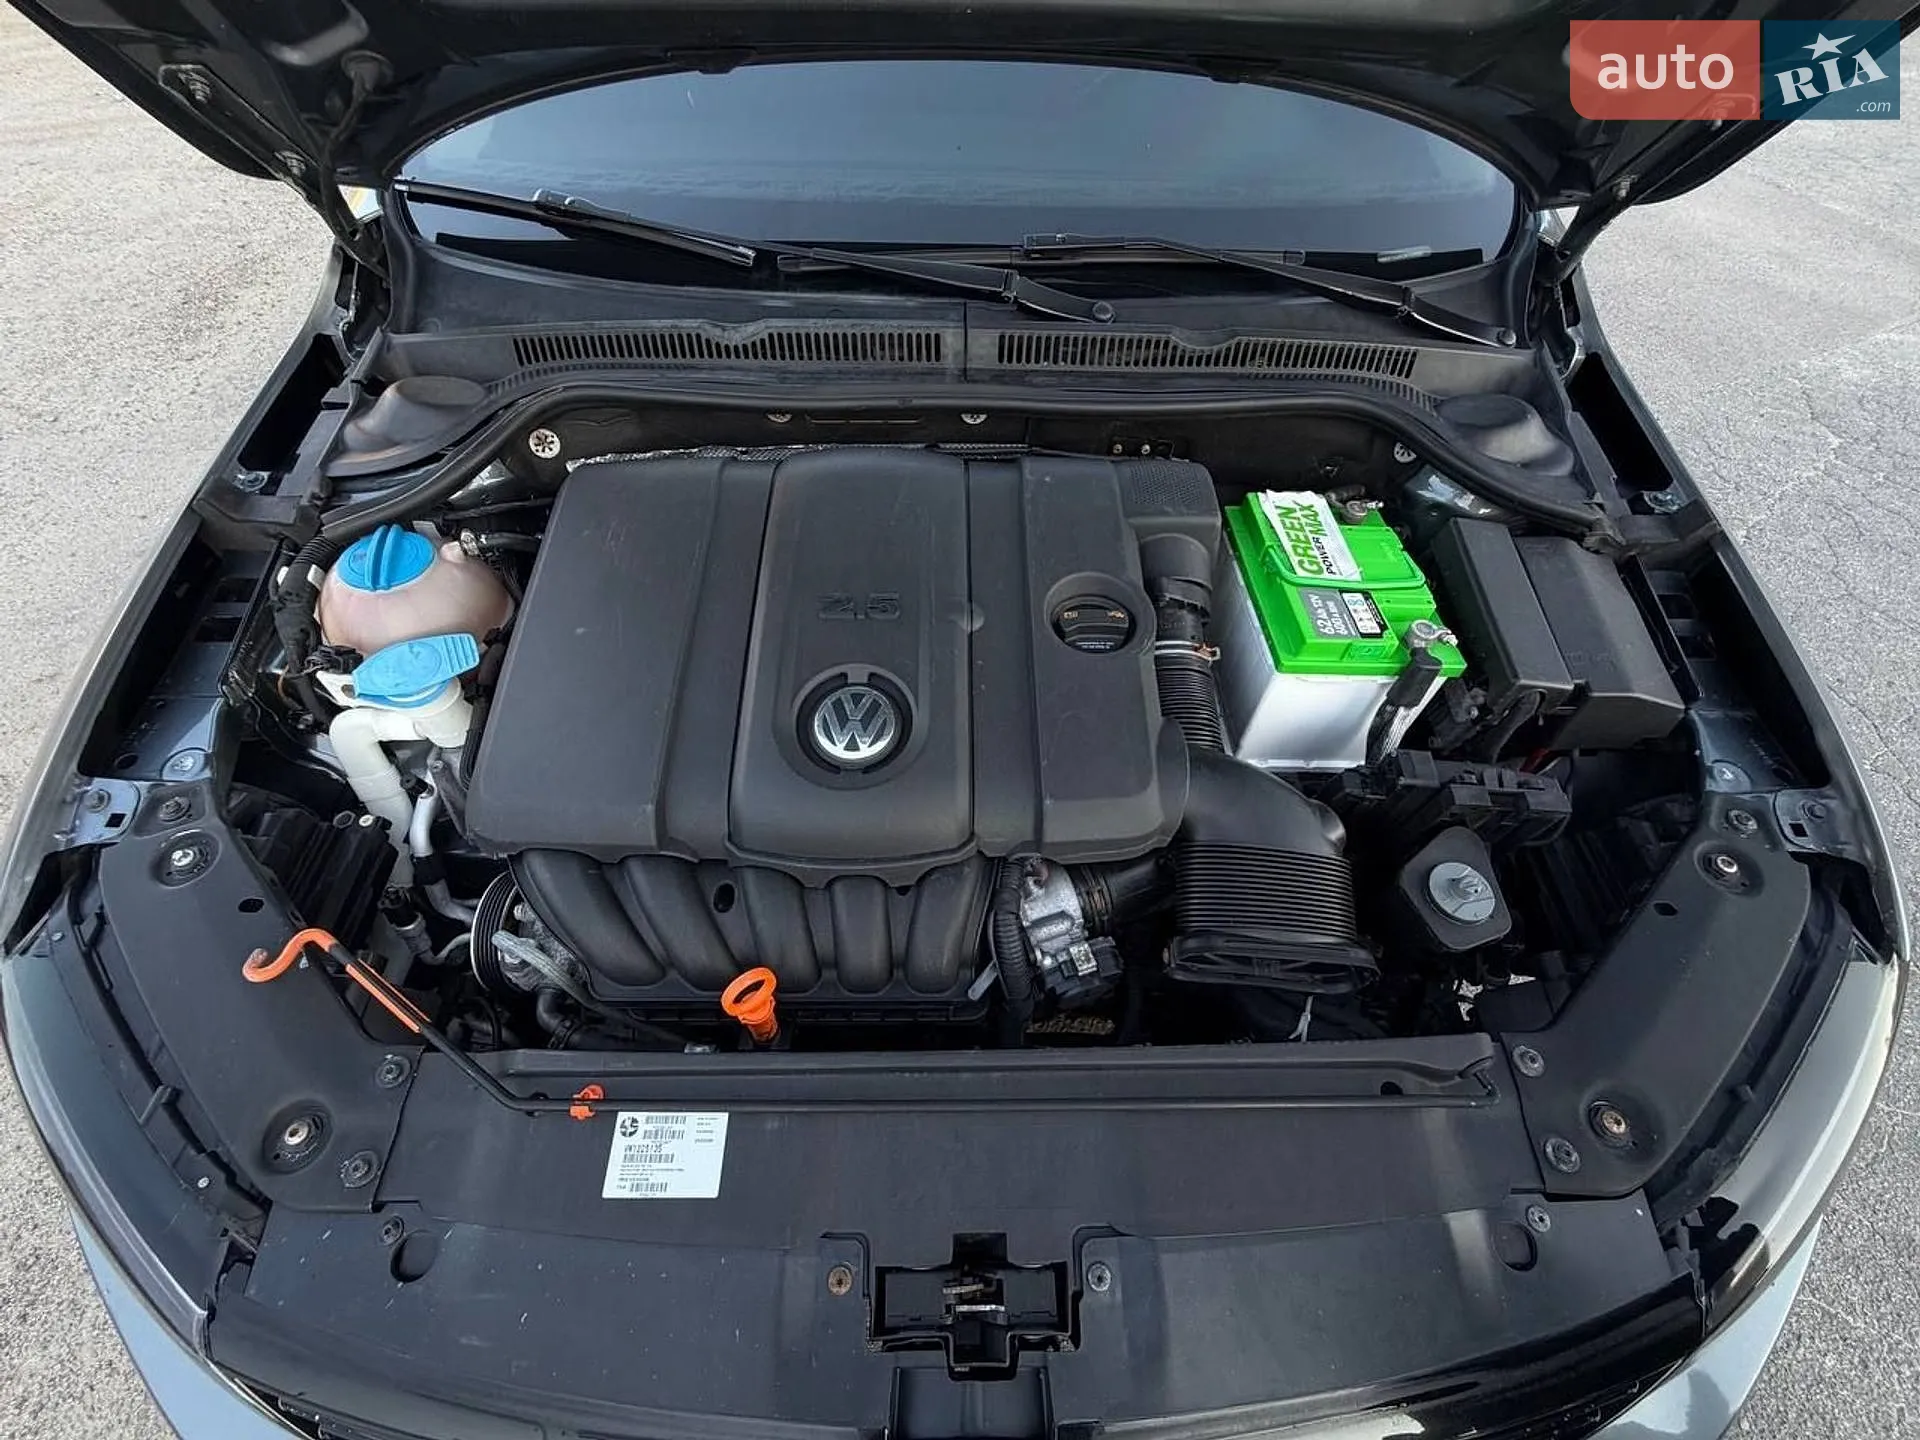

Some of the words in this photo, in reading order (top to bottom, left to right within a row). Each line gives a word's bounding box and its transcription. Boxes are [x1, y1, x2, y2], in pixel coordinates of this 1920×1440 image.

[1292, 500, 1328, 537] MAX
[1274, 504, 1324, 575] GREEN
[1312, 536, 1337, 575] POWER
[816, 592, 900, 620] 2.5
[1317, 619, 1335, 635] 62
[813, 686, 896, 760] VW
